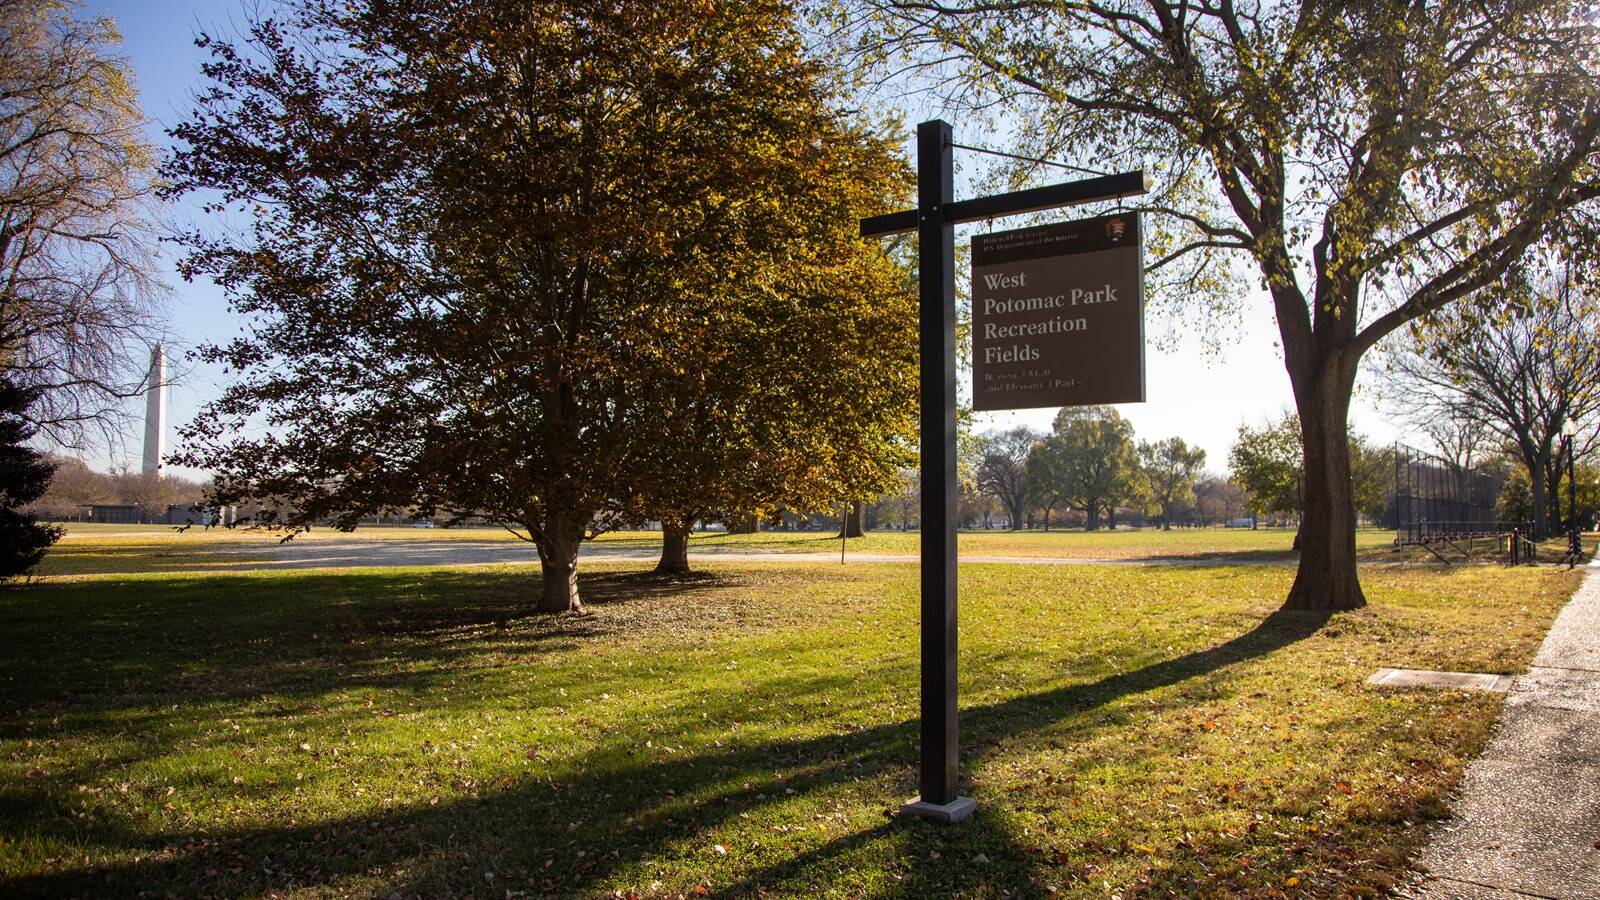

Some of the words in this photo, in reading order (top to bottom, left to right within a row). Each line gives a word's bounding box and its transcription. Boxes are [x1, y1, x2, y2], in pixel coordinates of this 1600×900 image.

[983, 272, 1027, 290] West
[984, 295, 1065, 315] Potomac
[1070, 284, 1118, 306] Park
[984, 316, 1088, 340] Recreation
[984, 344, 1040, 364] Fields
